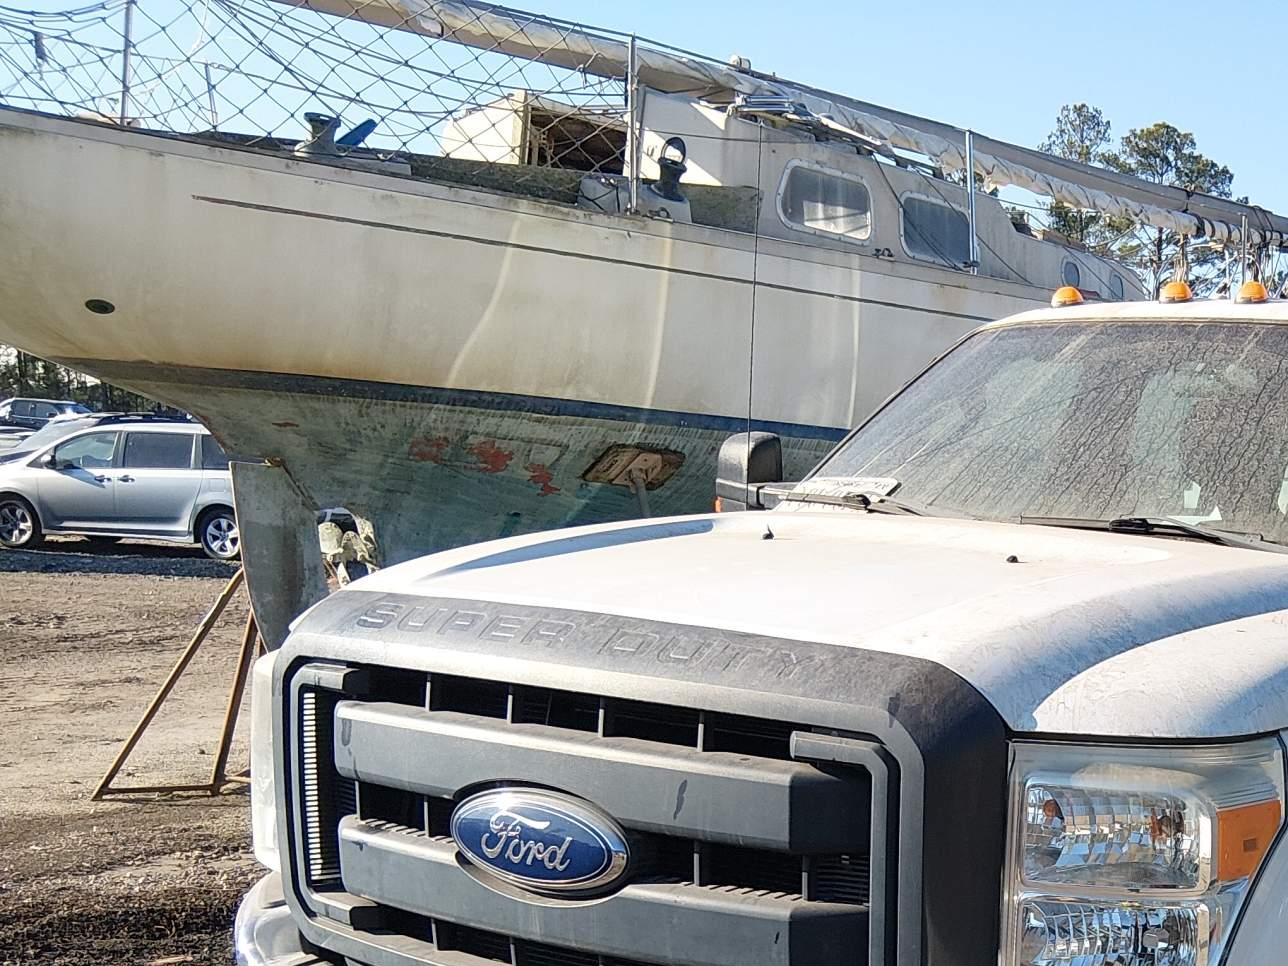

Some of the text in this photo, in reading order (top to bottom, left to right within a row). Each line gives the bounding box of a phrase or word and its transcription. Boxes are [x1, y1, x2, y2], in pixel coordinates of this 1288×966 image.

[355, 601, 814, 678] SUPER DUTY
[481, 807, 573, 872] Ford
